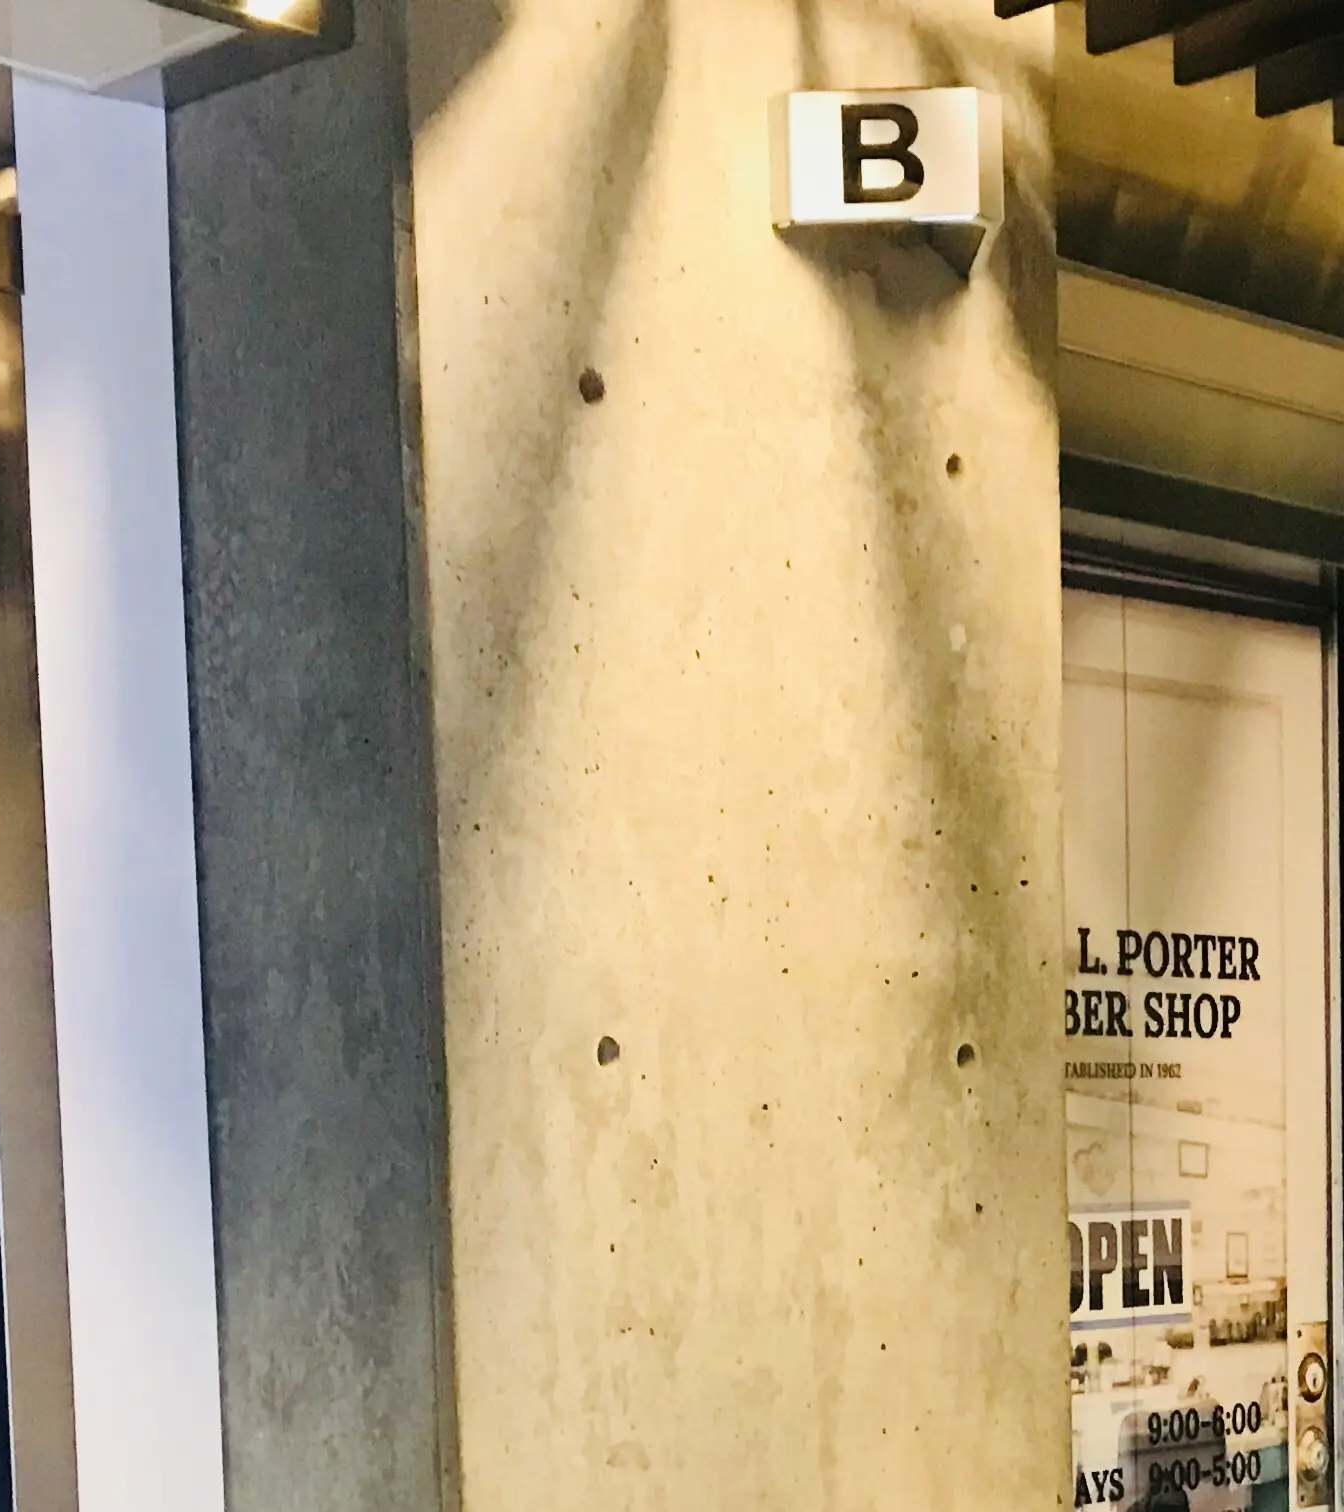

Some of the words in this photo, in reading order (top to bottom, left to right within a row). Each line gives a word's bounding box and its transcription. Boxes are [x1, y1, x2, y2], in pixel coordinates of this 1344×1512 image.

[841, 103, 924, 203] B
[1077, 927, 1107, 975] L.
[1116, 929, 1260, 981] PORTER
[1144, 992, 1241, 1038] SHOP
[1140, 1062, 1153, 1079] IN
